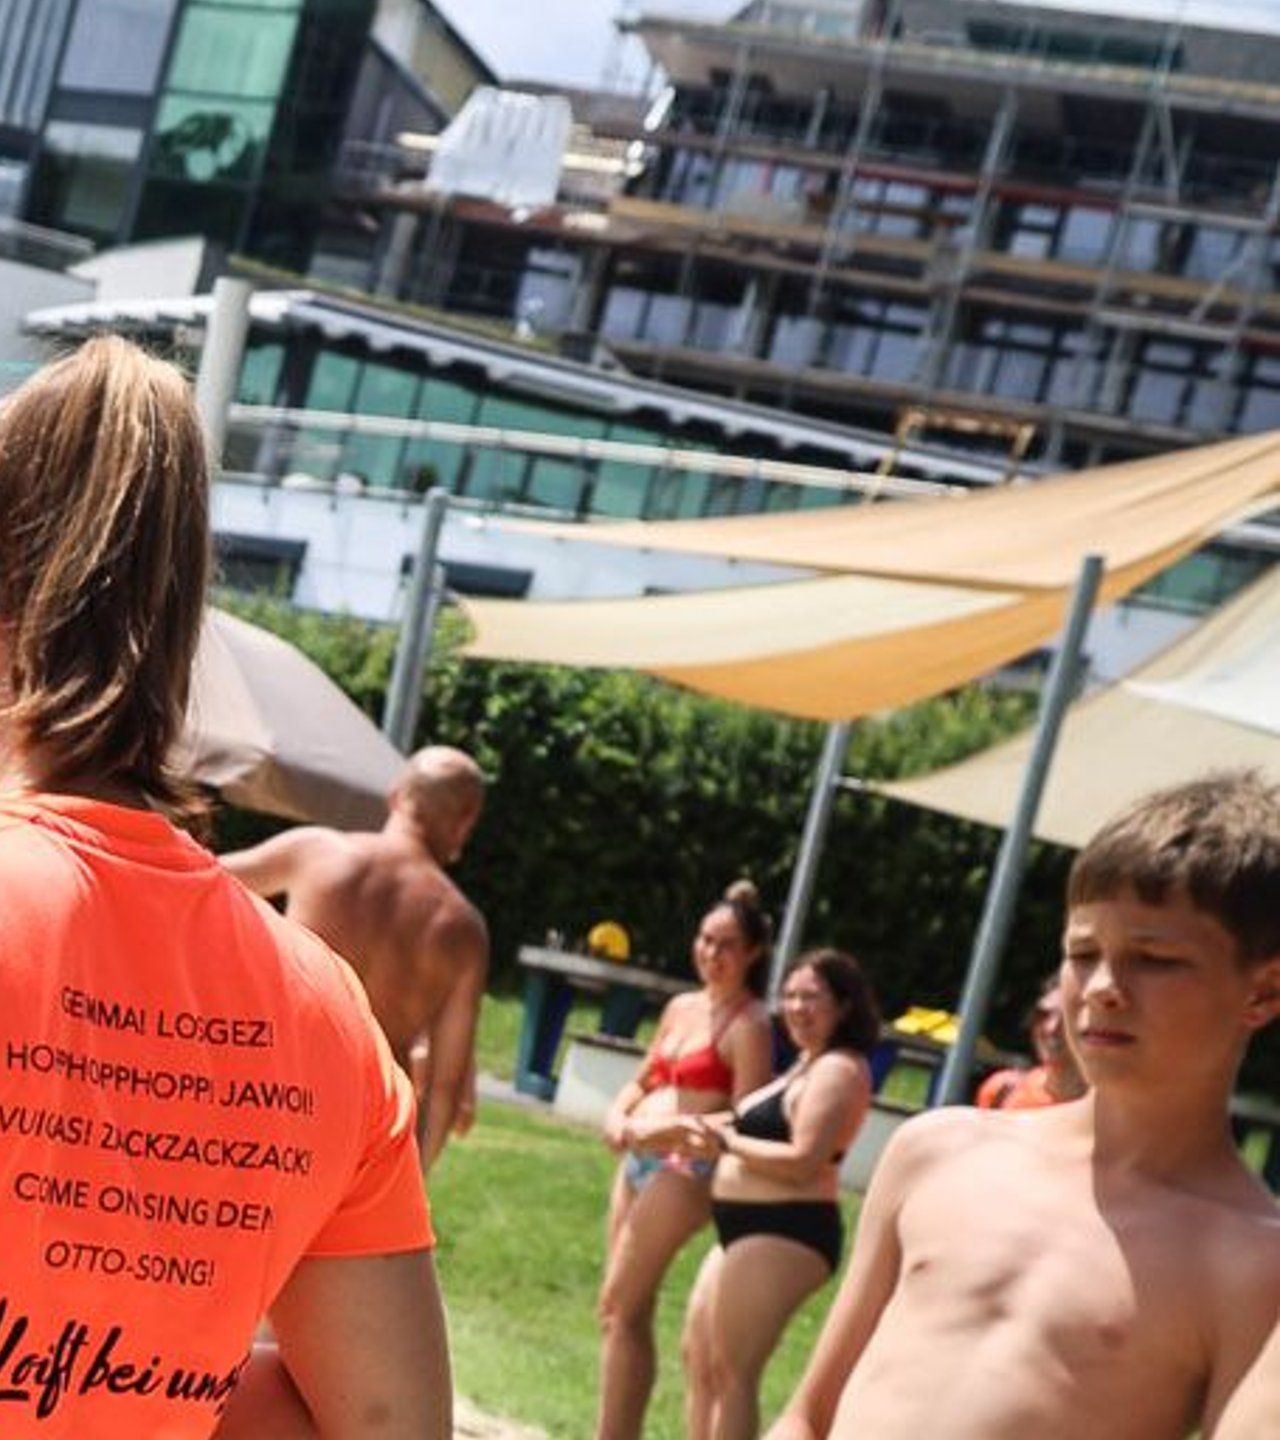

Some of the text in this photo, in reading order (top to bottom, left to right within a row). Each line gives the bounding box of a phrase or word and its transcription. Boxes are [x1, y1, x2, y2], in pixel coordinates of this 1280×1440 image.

[13, 1171, 91, 1209] COME
[143, 1192, 209, 1227] SING
[44, 1240, 215, 1288] OTTO-SONG!
[78, 1325, 166, 1396] bei
